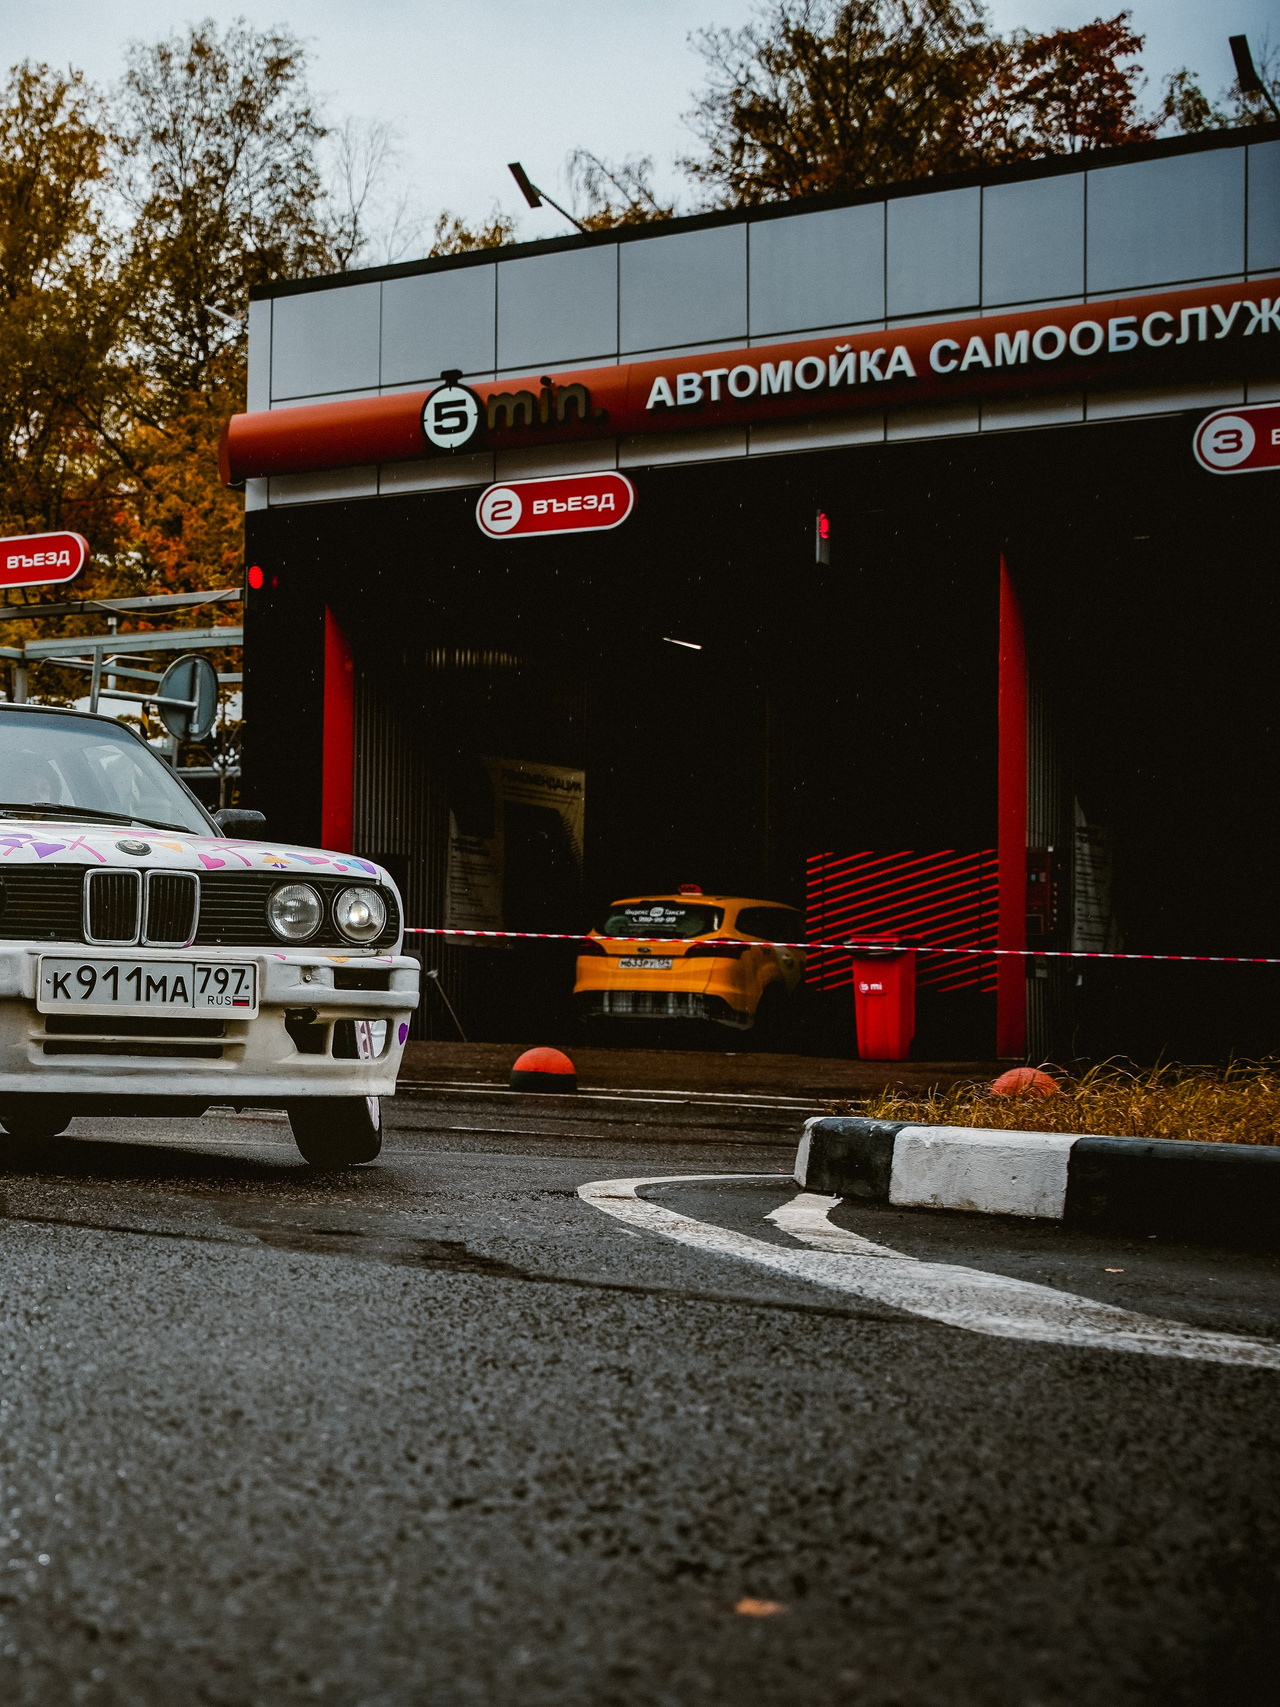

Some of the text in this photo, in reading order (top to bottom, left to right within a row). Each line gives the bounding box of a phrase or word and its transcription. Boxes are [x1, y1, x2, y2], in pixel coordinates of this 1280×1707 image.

[645, 343, 918, 410] АВТОМОЙКА
[433, 398, 469, 436] 5
[1213, 428, 1243, 454] 3
[490, 493, 615, 522] 2 ВЪЕЗД
[6, 550, 71, 569] ВЪЕЗД
[52, 963, 246, 1003] К911МА 797
[207, 995, 232, 1006] RUS
